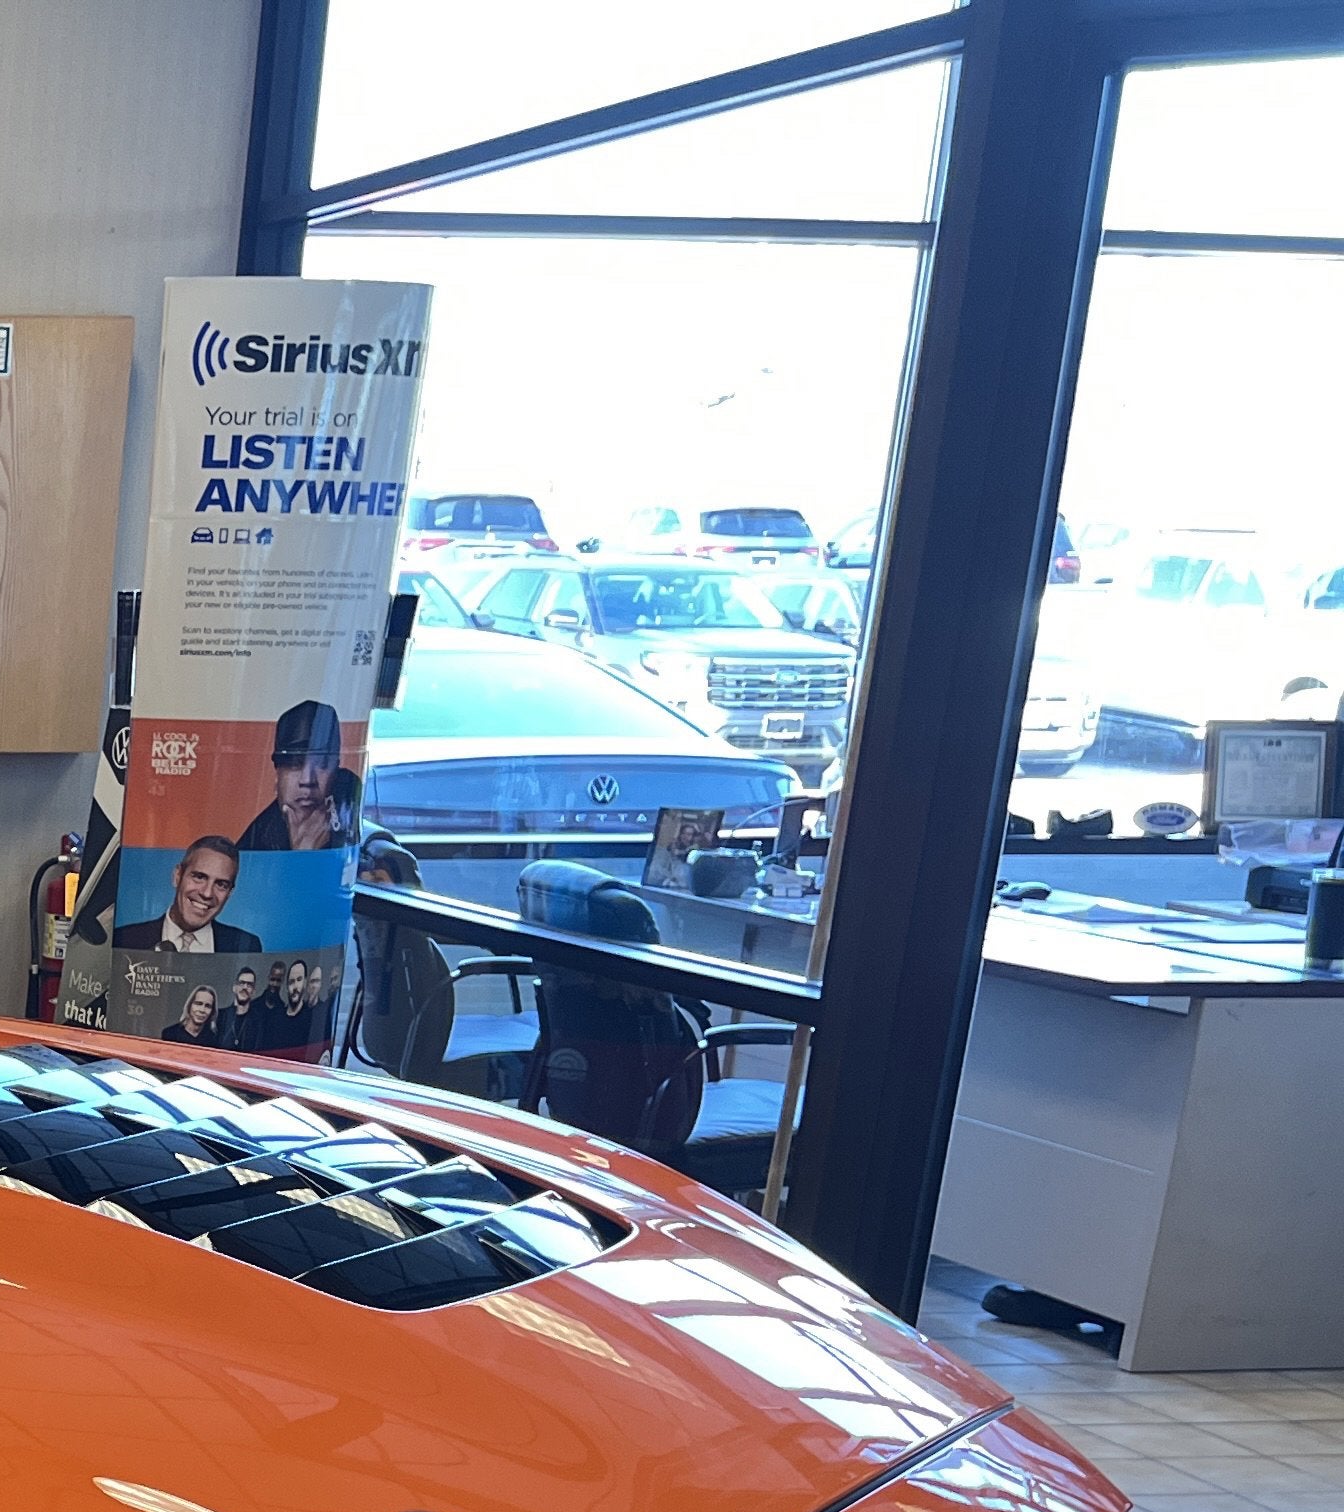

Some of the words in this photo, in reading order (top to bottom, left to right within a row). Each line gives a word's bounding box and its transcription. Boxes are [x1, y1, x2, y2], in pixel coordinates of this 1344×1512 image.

[205, 406, 257, 426] Your
[265, 406, 304, 427] trial
[312, 408, 326, 427] is
[334, 412, 358, 427] on
[201, 434, 366, 471] LISTEN
[152, 741, 197, 759] ROCK
[152, 759, 197, 769] BELLS
[155, 767, 191, 776] RADIO
[557, 812, 648, 823] JETTA
[69, 969, 102, 997] Make
[136, 974, 186, 983] MATTHEWS
[64, 1000, 93, 1026] that
